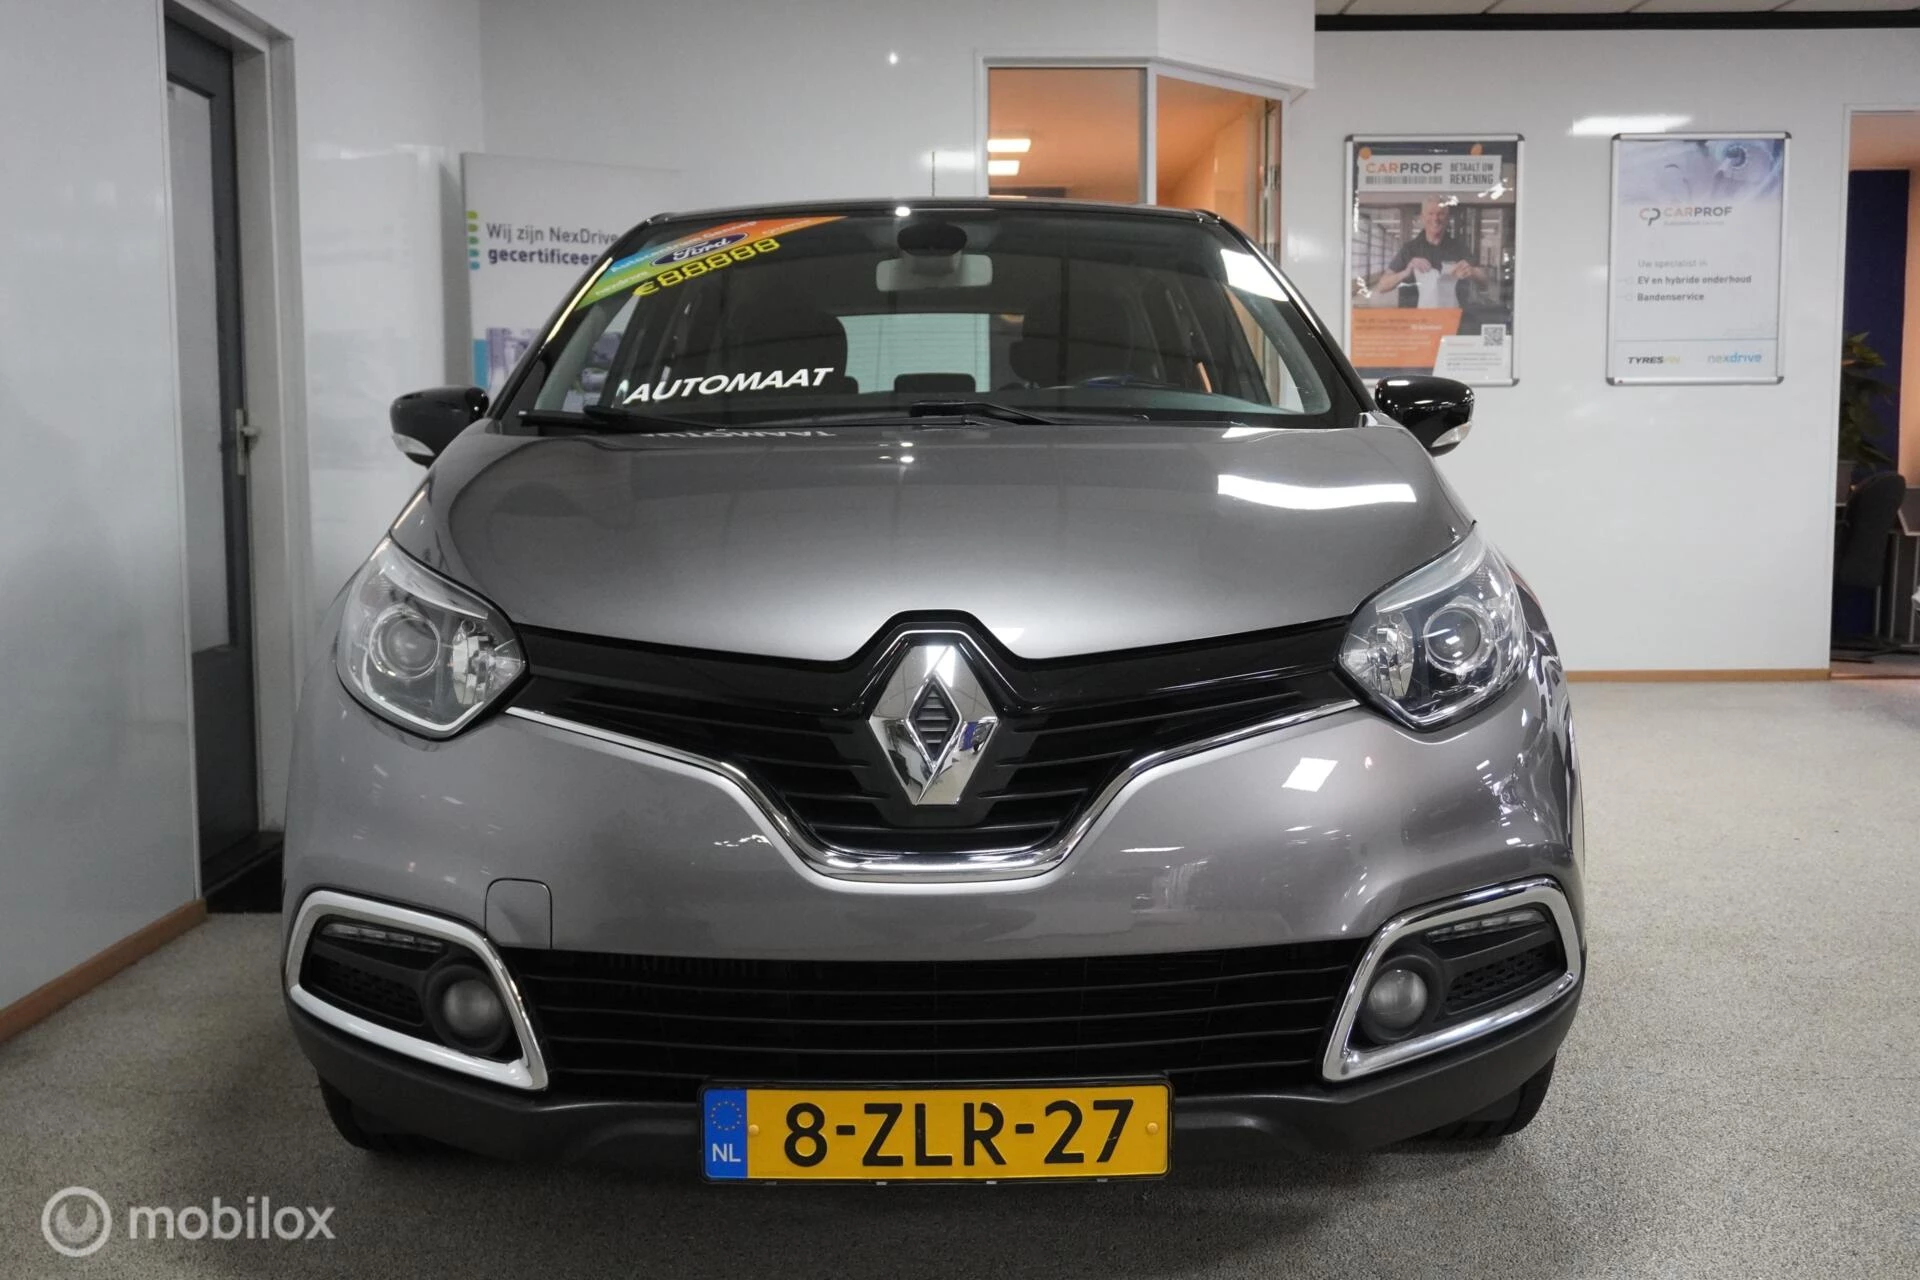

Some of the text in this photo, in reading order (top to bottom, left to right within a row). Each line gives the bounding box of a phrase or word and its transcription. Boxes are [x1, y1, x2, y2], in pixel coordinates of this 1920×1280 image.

[1365, 162, 1443, 174] CARPROF
[1450, 173, 1494, 184] REKENING
[1663, 206, 1733, 217] CARPROF
[486, 223, 618, 245] Wij zijn NexDrive
[673, 238, 731, 261] Ford
[488, 248, 597, 265] gecertificeer
[1655, 259, 1697, 269] specialist
[1638, 275, 1752, 286] EV en hybride onderhoud
[1637, 292, 1705, 302] Bandenservice
[1707, 352, 1762, 364] nexdrive
[622, 367, 834, 404] AUTOMAAT
[783, 1098, 1135, 1168] 8-ZLR-27
[712, 1143, 742, 1163] NL
